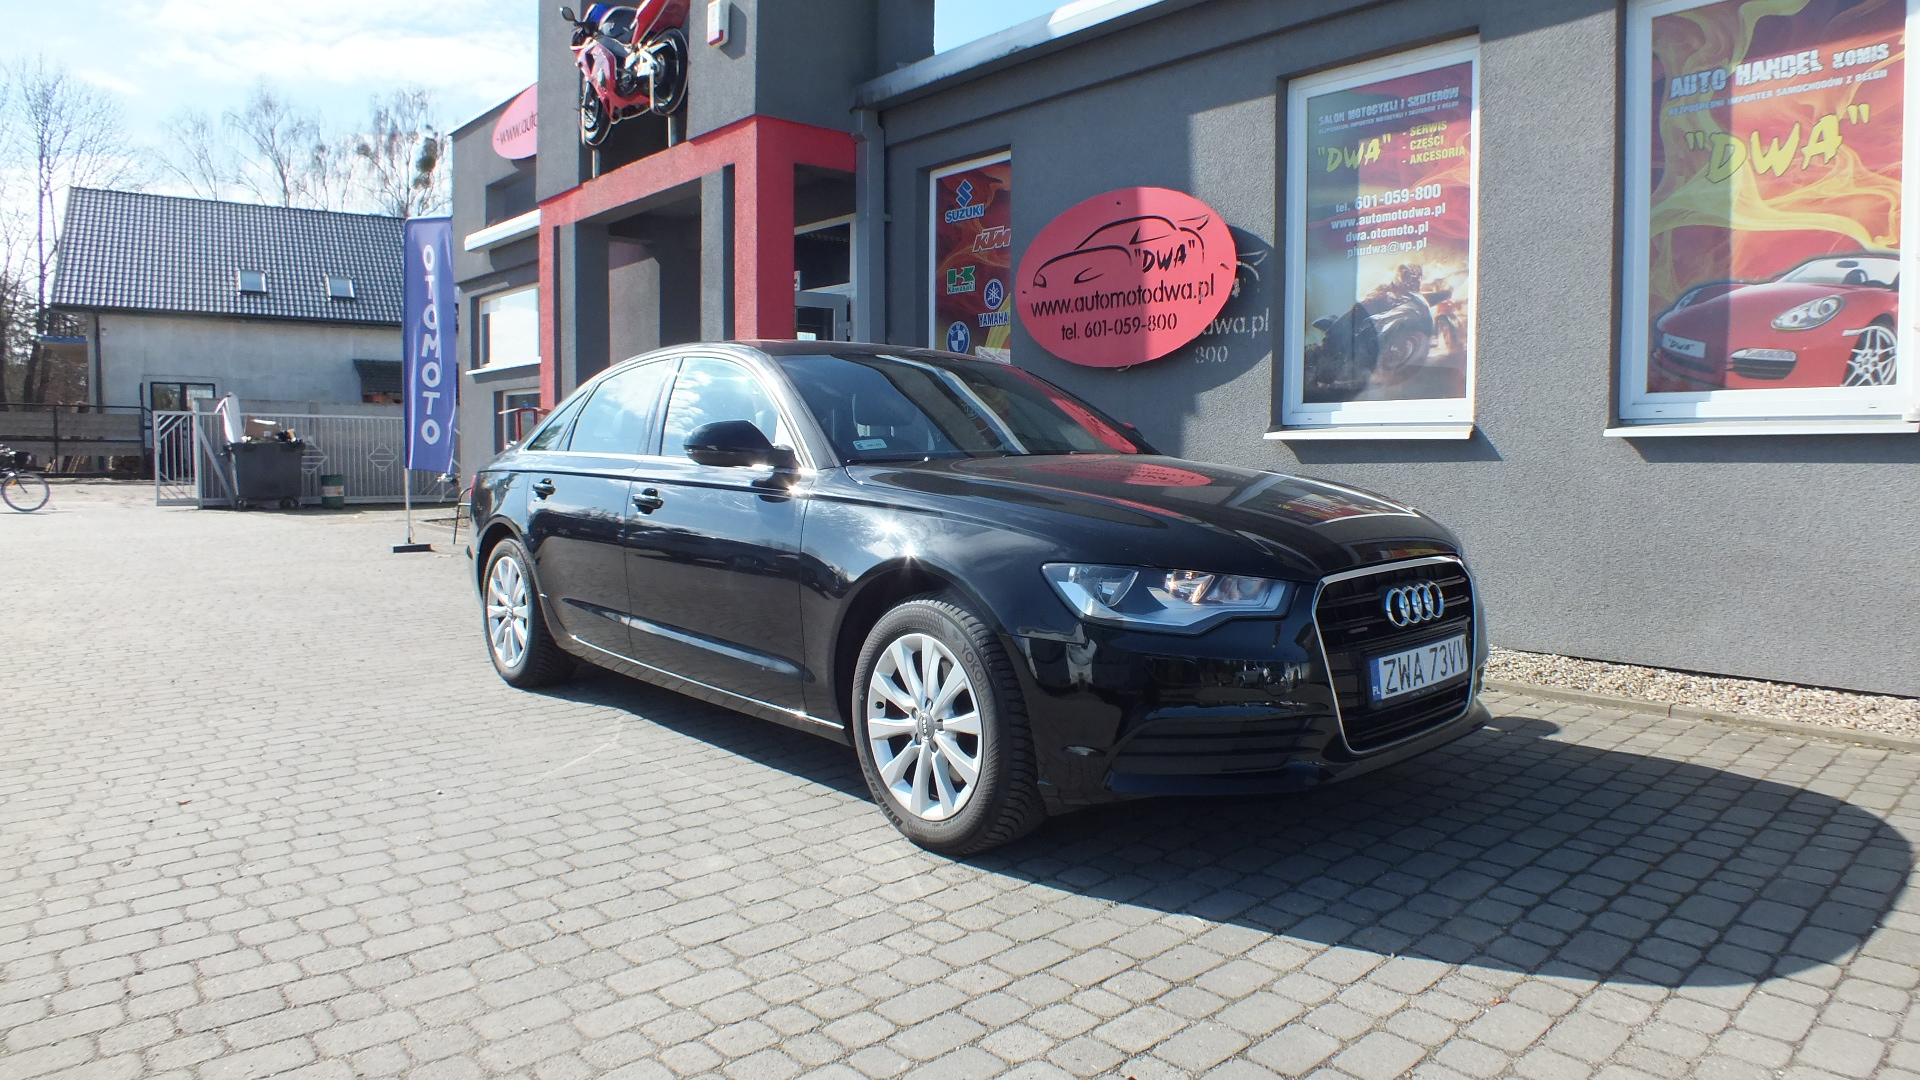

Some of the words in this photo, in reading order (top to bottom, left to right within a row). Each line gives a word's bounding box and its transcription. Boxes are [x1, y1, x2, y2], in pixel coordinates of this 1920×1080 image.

[1669, 68, 1726, 99] AUTO
[1735, 49, 1823, 86] HANDEL
[1832, 43, 1889, 70] KOMIS
[1729, 90, 1774, 104] IMPORTER
[1776, 76, 1844, 97] SAMOCHODÓW
[1319, 112, 1345, 126] SALON
[1347, 99, 1399, 120] MOTOCYKLI
[1407, 85, 1460, 108] SKUTERÓW
[1409, 120, 1448, 137] SERWIS
[1409, 133, 1444, 152] CZĘŚCI
[1317, 132, 1393, 173] "DWA"
[1409, 145, 1467, 165] AKCESORIA
[1685, 103, 1870, 184] "DWA"
[1335, 203, 1350, 213] tel.
[1354, 183, 1442, 209] 601-059-800
[945, 204, 984, 223] SUZUKI
[1330, 203, 1446, 230] www.automotodwa.pl
[972, 226, 1011, 252] KTM
[1345, 221, 1429, 243] dwa.otomoto.pl
[1134, 238, 1196, 274] "DWA"
[1347, 237, 1427, 261] phudwa@vp.pl
[1031, 273, 1215, 318] www.automotodwa.pl
[978, 311, 1009, 327] YAMAHA
[1061, 322, 1080, 341] tel.
[1084, 312, 1178, 338] 601-059-800
[421, 244, 442, 446] OTOMOTO
[1383, 652, 1424, 694] ZWA
[1372, 685, 1381, 696] PL
